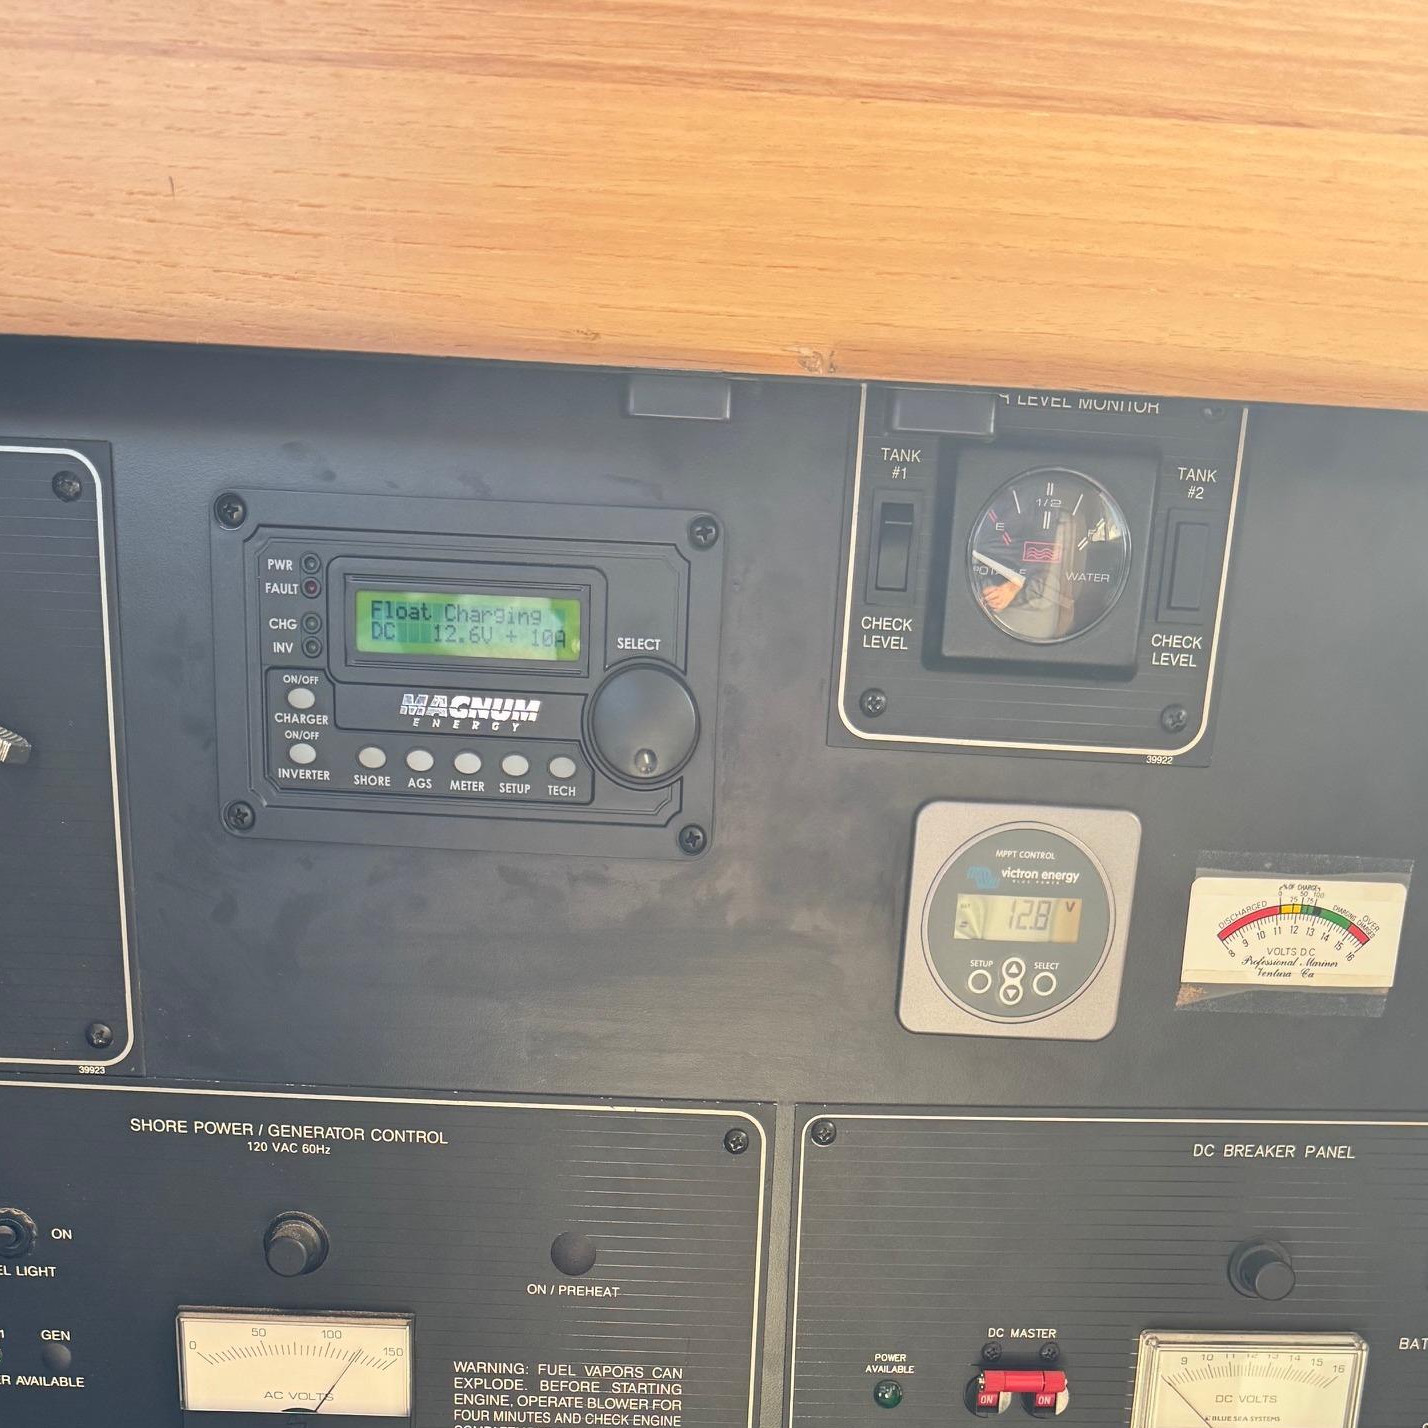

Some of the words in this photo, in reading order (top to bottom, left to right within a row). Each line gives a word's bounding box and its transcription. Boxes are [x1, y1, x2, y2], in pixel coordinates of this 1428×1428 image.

[881, 448, 921, 463] TANK
[892, 466, 907, 480] #1
[1178, 467, 1217, 482] TANK
[1187, 486, 1204, 499] #2
[1036, 499, 1061, 507] 1/2
[267, 559, 292, 571] PWR
[1066, 571, 1110, 583] WATER
[265, 582, 298, 595] FAULT
[371, 600, 432, 621] Float
[444, 604, 542, 625] Charging
[269, 618, 297, 630] CHG
[861, 616, 912, 631] CHECK
[371, 621, 395, 640] DC
[273, 641, 293, 654] INV
[617, 637, 660, 651] SELECT
[863, 635, 908, 650] LEVEL
[1151, 634, 1202, 649] CHECK
[1152, 652, 1197, 667] LEVEL
[283, 674, 318, 686] ON/OFF
[399, 694, 541, 722] MAGNUM
[274, 713, 328, 726] CHARGER
[284, 730, 319, 741] ON/OFF
[1146, 756, 1173, 765] 39922
[278, 768, 330, 781] INVERTER
[354, 774, 391, 787] SHORE
[408, 777, 432, 790] AGS
[450, 779, 484, 792] METER
[499, 782, 530, 795] SETUP
[548, 784, 575, 797] TECH
[996, 850, 1017, 859] MPPT
[1019, 851, 1055, 860] CONTROL
[1001, 866, 1039, 879] victron
[1041, 870, 1080, 883] energy
[1267, 947, 1297, 957] VOLTS
[970, 960, 993, 968] SETUP
[1034, 962, 1059, 970] SELECT
[1241, 955, 1299, 969] Professional
[1300, 959, 1339, 968] Mariner
[78, 1065, 105, 1075] 39923
[130, 1118, 188, 1133] SHORE
[193, 1121, 253, 1136] POWER
[268, 1124, 364, 1141] GENERATOR
[370, 1128, 448, 1145] CONTROL
[247, 1142, 269, 1153] 120
[272, 1142, 299, 1154] VAC
[301, 1143, 331, 1156] 60Hz
[1193, 1144, 1216, 1158] DC
[1223, 1144, 1296, 1159] BREAKER
[1304, 1145, 1356, 1160] PANEL
[51, 1229, 72, 1240] ON
[16, 1266, 56, 1277] LIGHT
[527, 1284, 547, 1296] ON
[558, 1285, 621, 1297] PREHEAT
[0, 1329, 5, 1339] 1
[41, 1329, 70, 1341] GEN
[251, 1328, 266, 1337] 50
[322, 1330, 342, 1339] 100
[988, 1328, 1005, 1338] DC
[1010, 1328, 1057, 1339] MASTER
[383, 1347, 403, 1357] 150
[453, 1361, 529, 1375] WARNING:
[538, 1364, 576, 1377] FUEL
[584, 1365, 644, 1379] VAPORS
[652, 1367, 683, 1379] CAN
[16, 1375, 84, 1388] AVAILABLE
[453, 1378, 528, 1391] EXPLODE.
[540, 1380, 601, 1393] BEFORE
[611, 1382, 682, 1395] STARTING
[264, 1391, 284, 1400] AC
[288, 1392, 334, 1401] VOLTS
[454, 1394, 514, 1407] ENGINE,
[517, 1395, 583, 1409] OPERATE
[587, 1397, 650, 1410] BLOWER
[652, 1399, 682, 1411] FOR
[980, 1395, 995, 1404] ON
[1038, 1396, 1051, 1405] ON
[1215, 1395, 1233, 1403] DC
[1239, 1395, 1277, 1403] VOLTS
[454, 1410, 489, 1421] FOUR
[493, 1411, 551, 1424] MINUTES
[554, 1413, 581, 1425] AND
[585, 1413, 629, 1426] CHECK
[633, 1415, 681, 1427] ENGINE
